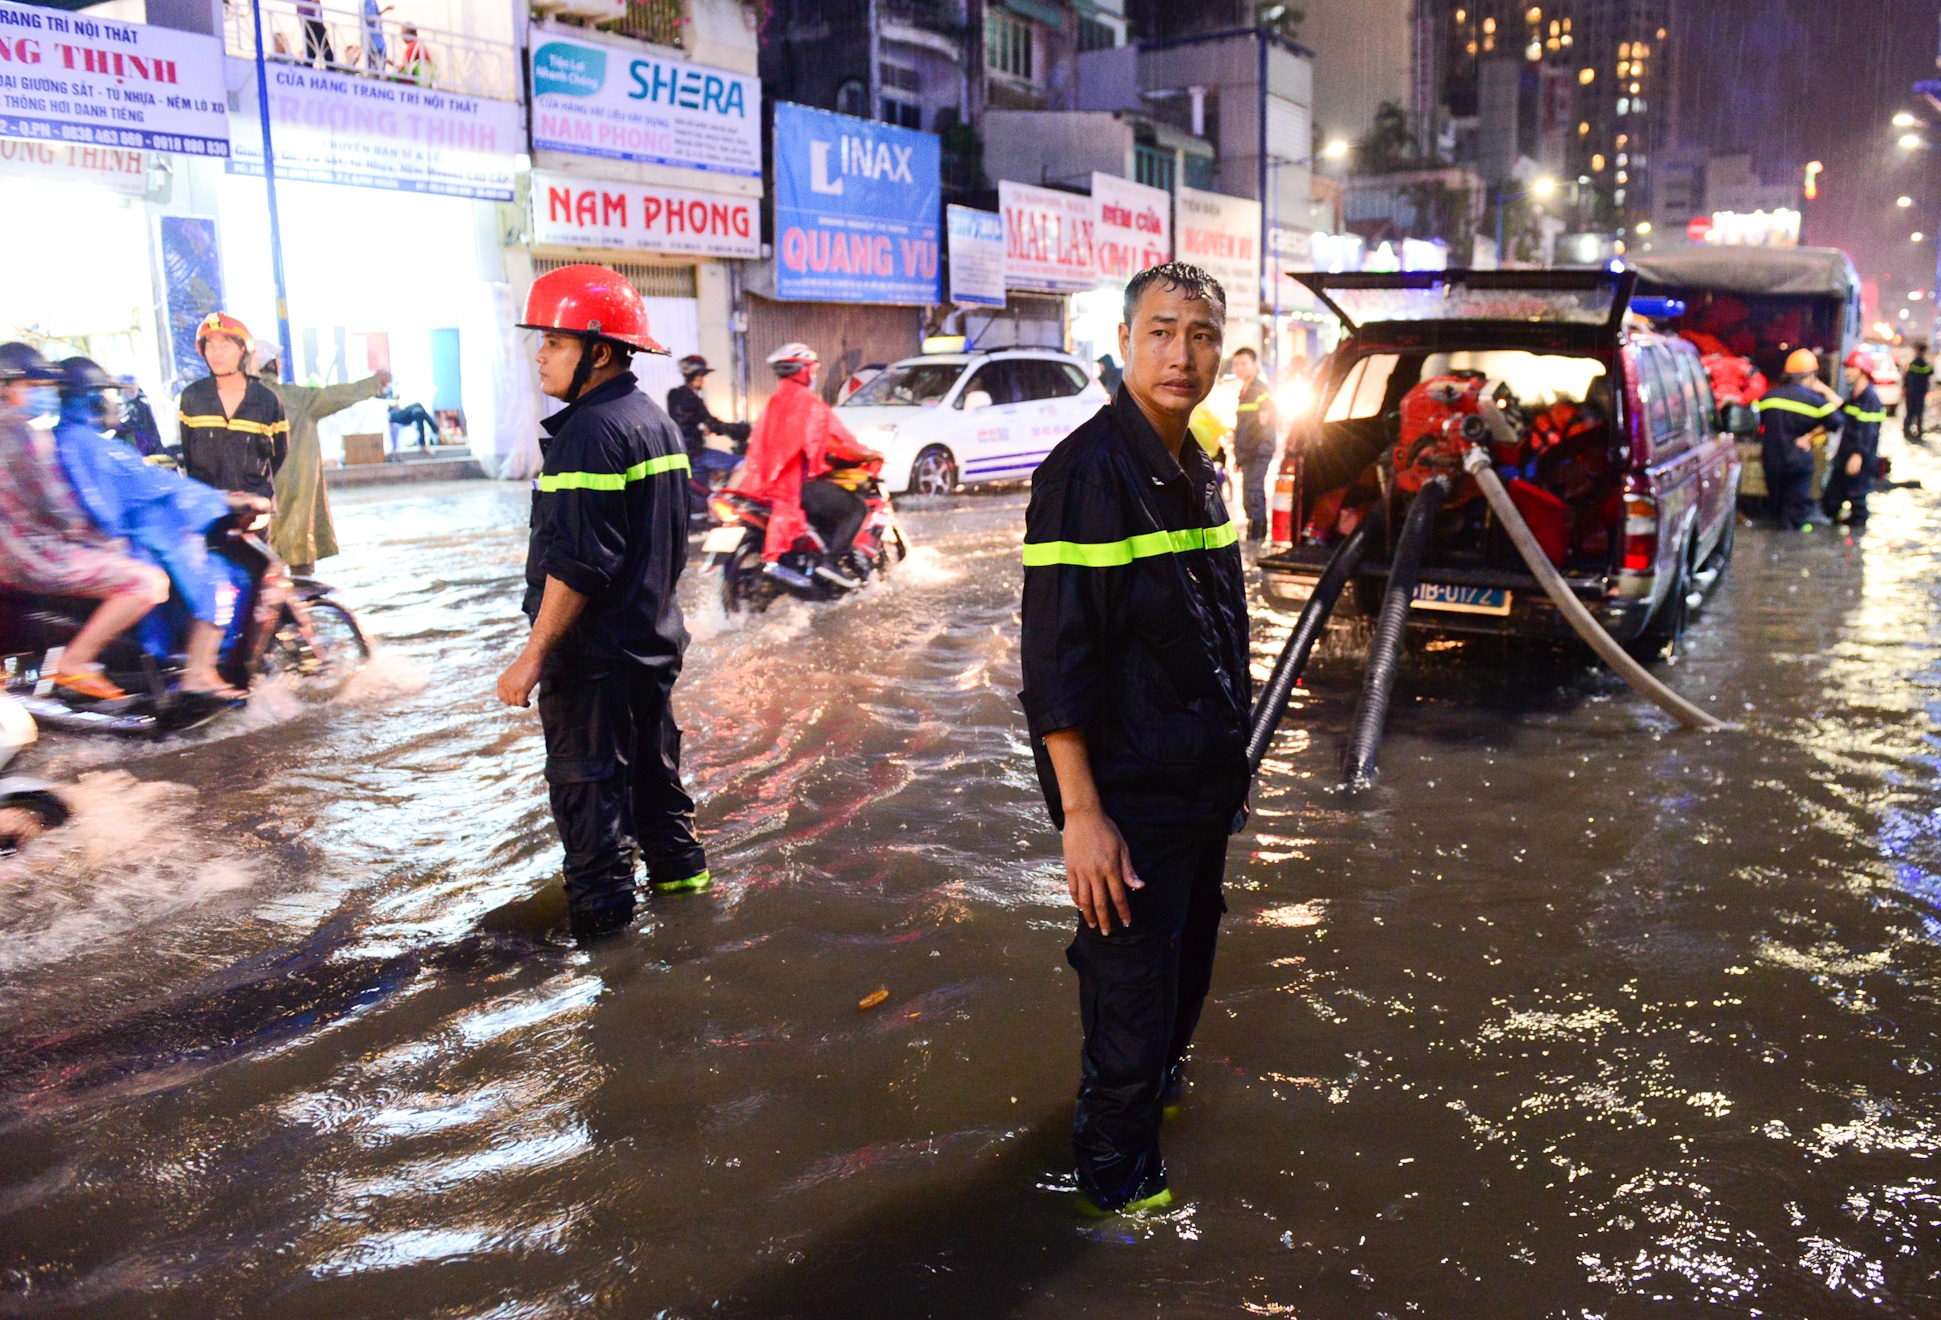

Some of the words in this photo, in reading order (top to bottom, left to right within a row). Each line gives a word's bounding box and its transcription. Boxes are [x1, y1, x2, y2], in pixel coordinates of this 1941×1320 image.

[45, 15, 70, 33] TRÍ
[74, 19, 100, 40] NỘI
[104, 24, 138, 44] THẤT
[54, 43, 178, 84] THỊNH
[21, 75, 68, 94] GIƯỜNG
[72, 79, 94, 97] SẮT
[106, 84, 120, 101] TỦ
[124, 90, 156, 108] NHỰA
[167, 94, 191, 110] NỆM
[211, 102, 225, 114] XO
[51, 99, 71, 114] HƠI
[75, 103, 107, 118] DANH
[111, 106, 145, 122] TIẾNG
[277, 68, 305, 87] CỬA
[310, 76, 348, 94] HÀNG
[353, 84, 395, 101] TRANG
[400, 90, 420, 105] TRÍ
[423, 94, 445, 111] NỘI
[449, 99, 479, 113] THẤT
[628, 59, 746, 119] SHERA
[540, 114, 593, 141] NAM
[599, 122, 672, 154] PHONG
[841, 135, 914, 184] INAX
[548, 186, 627, 229] NAM
[643, 196, 751, 239] PHONG
[782, 226, 894, 277] QUANG
[900, 229, 938, 280] VŨ
[1006, 207, 1048, 263] MAI
[1056, 216, 1095, 268] LAN
